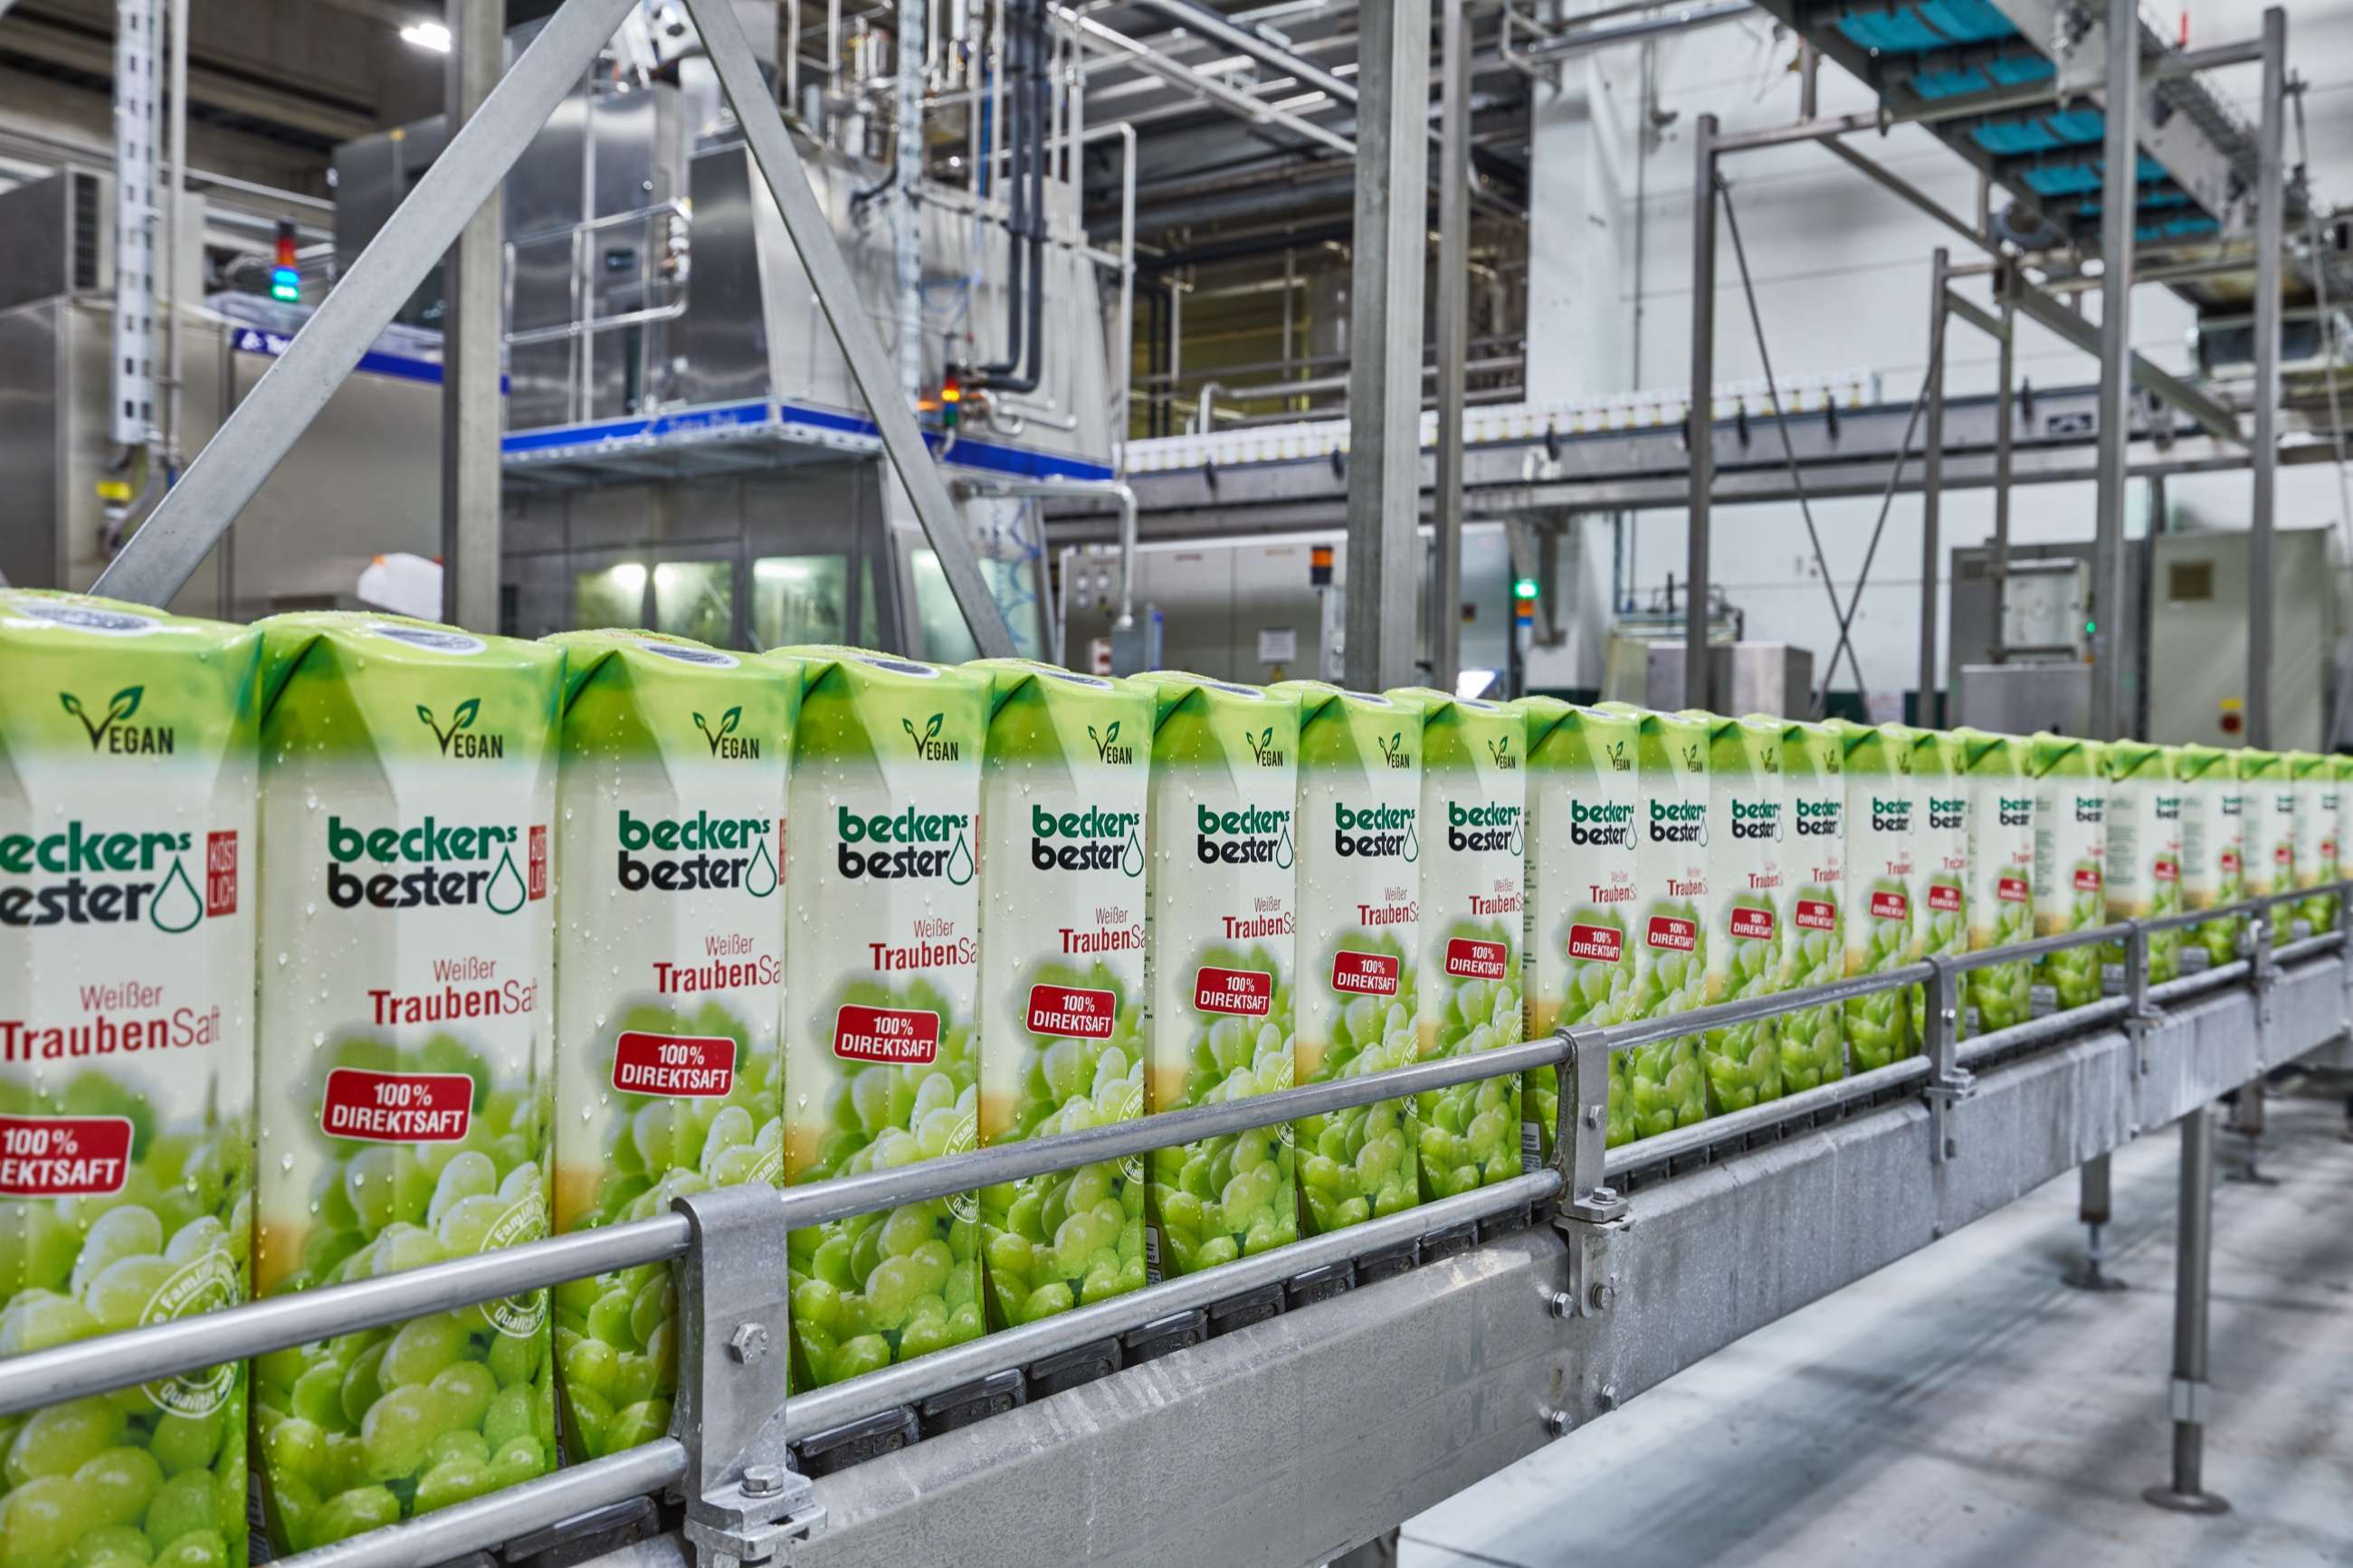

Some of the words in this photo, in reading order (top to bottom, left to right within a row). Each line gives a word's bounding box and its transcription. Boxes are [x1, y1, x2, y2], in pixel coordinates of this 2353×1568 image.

[59, 685, 174, 755] VEGAN
[416, 698, 503, 758] VEGAN
[692, 706, 760, 760] VEGAN
[902, 713, 958, 761] VEGAN
[1088, 721, 1132, 765] VEGAN
[1245, 727, 1283, 767] VEGAN
[1378, 732, 1410, 768] VEGAN
[1488, 736, 1516, 769] VEGAN
[1032, 804, 1140, 839] beckers
[1197, 803, 1290, 835] beckers
[1335, 803, 1415, 831] beckers
[1448, 801, 1521, 827] beckers
[1571, 799, 1635, 823] beckers
[1650, 799, 1707, 821] beckers
[619, 810, 771, 851] beckers
[838, 806, 968, 843] beckers
[1571, 822, 1626, 845] bester
[1650, 821, 1700, 842] bester
[0, 821, 192, 875] eckers
[329, 816, 518, 863] beckers
[1197, 834, 1278, 864] bester
[1335, 830, 1405, 857] bester
[1448, 826, 1512, 852] bester
[838, 842, 951, 879] bester
[1032, 837, 1125, 871] bester
[618, 851, 749, 891] bester
[328, 862, 491, 909] bester
[0, 878, 156, 927] ester
[1254, 896, 1281, 913] Weißer
[913, 917, 955, 938] Weißer
[1096, 907, 1129, 927] Weißer
[1222, 912, 1296, 939] TraubenSa
[706, 933, 755, 956] Weißer
[1059, 924, 1146, 954] TraubenSa
[1572, 942, 1620, 959] DIREKTSAFT
[869, 936, 977, 971] TraubenSa
[1450, 957, 1503, 975] DIREKTSAFT
[1472, 946, 1495, 960] 100%
[433, 956, 497, 983] Weißer
[653, 955, 783, 993] TraubenSa
[1360, 960, 1386, 974] 100%
[1226, 976, 1255, 993] 100%
[1338, 972, 1396, 992] DIREKTSAFT
[81, 982, 164, 1012] Weißer
[1062, 995, 1095, 1012] 100%
[1200, 991, 1268, 1011] DIREKTSAFT
[873, 1016, 914, 1036] 100%
[1033, 1011, 1110, 1033] DIREKTSAFT
[658, 1044, 705, 1066] 100%
[841, 1033, 934, 1058] DIREKTSAFT
[621, 1063, 729, 1090] DIREKTSAFT
[374, 1083, 433, 1107] 100%
[331, 1105, 463, 1134] DIREKTSAFT
[5, 1128, 78, 1156] 100%
[0, 1159, 119, 1186] EKTSAFT
